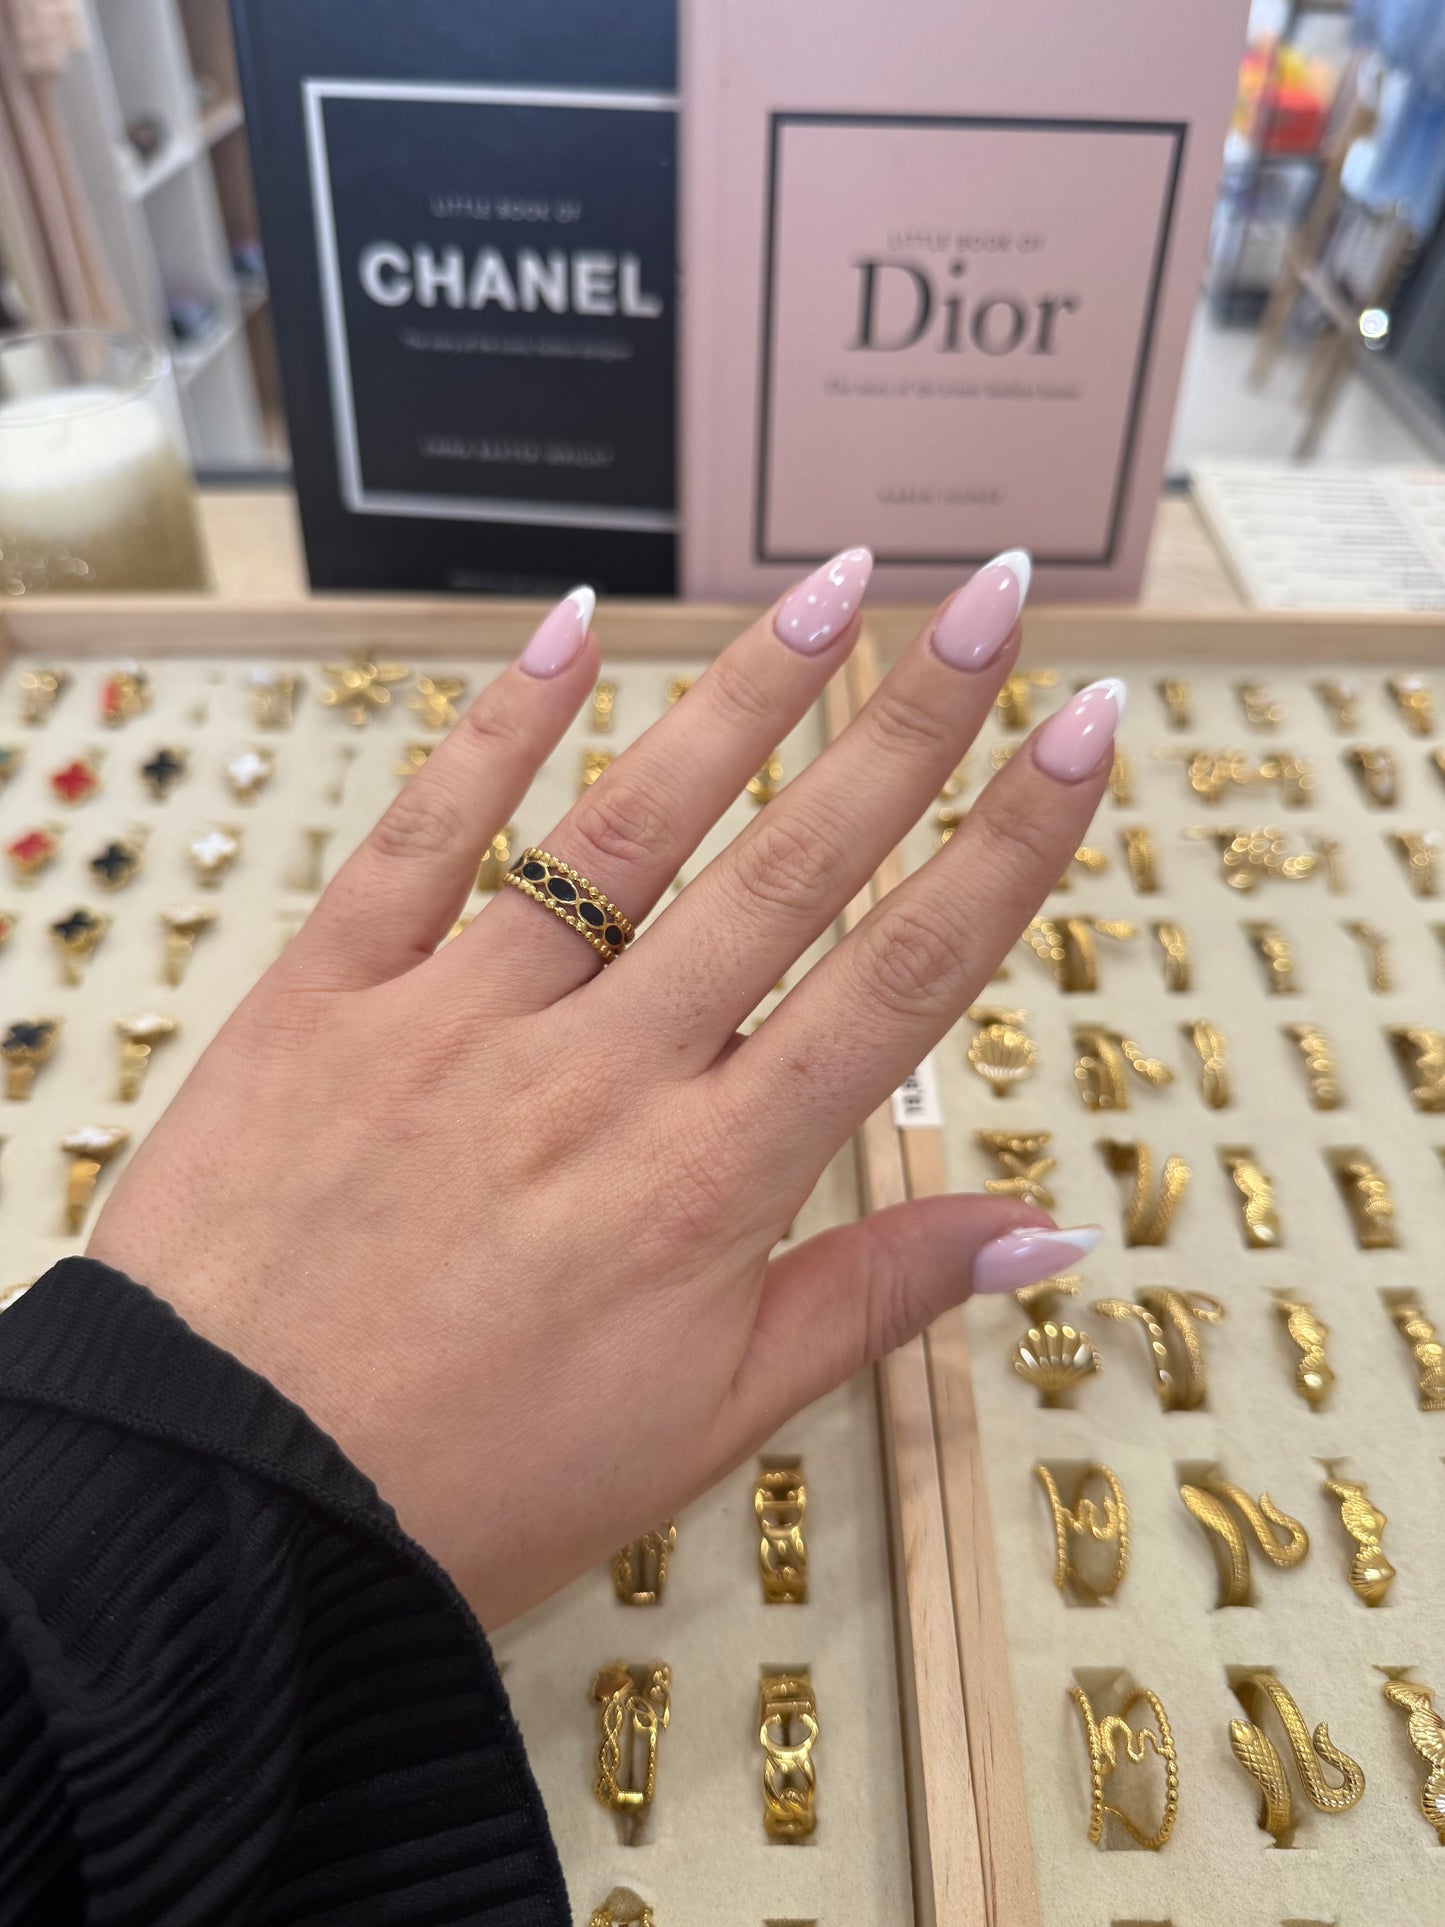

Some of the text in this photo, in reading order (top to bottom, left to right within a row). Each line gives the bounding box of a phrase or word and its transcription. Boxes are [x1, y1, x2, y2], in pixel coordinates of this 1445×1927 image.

[494, 198, 550, 222] BOOK
[955, 231, 1013, 253] BOOK
[358, 241, 664, 319] CHANEL
[846, 254, 1081, 357] Dior
